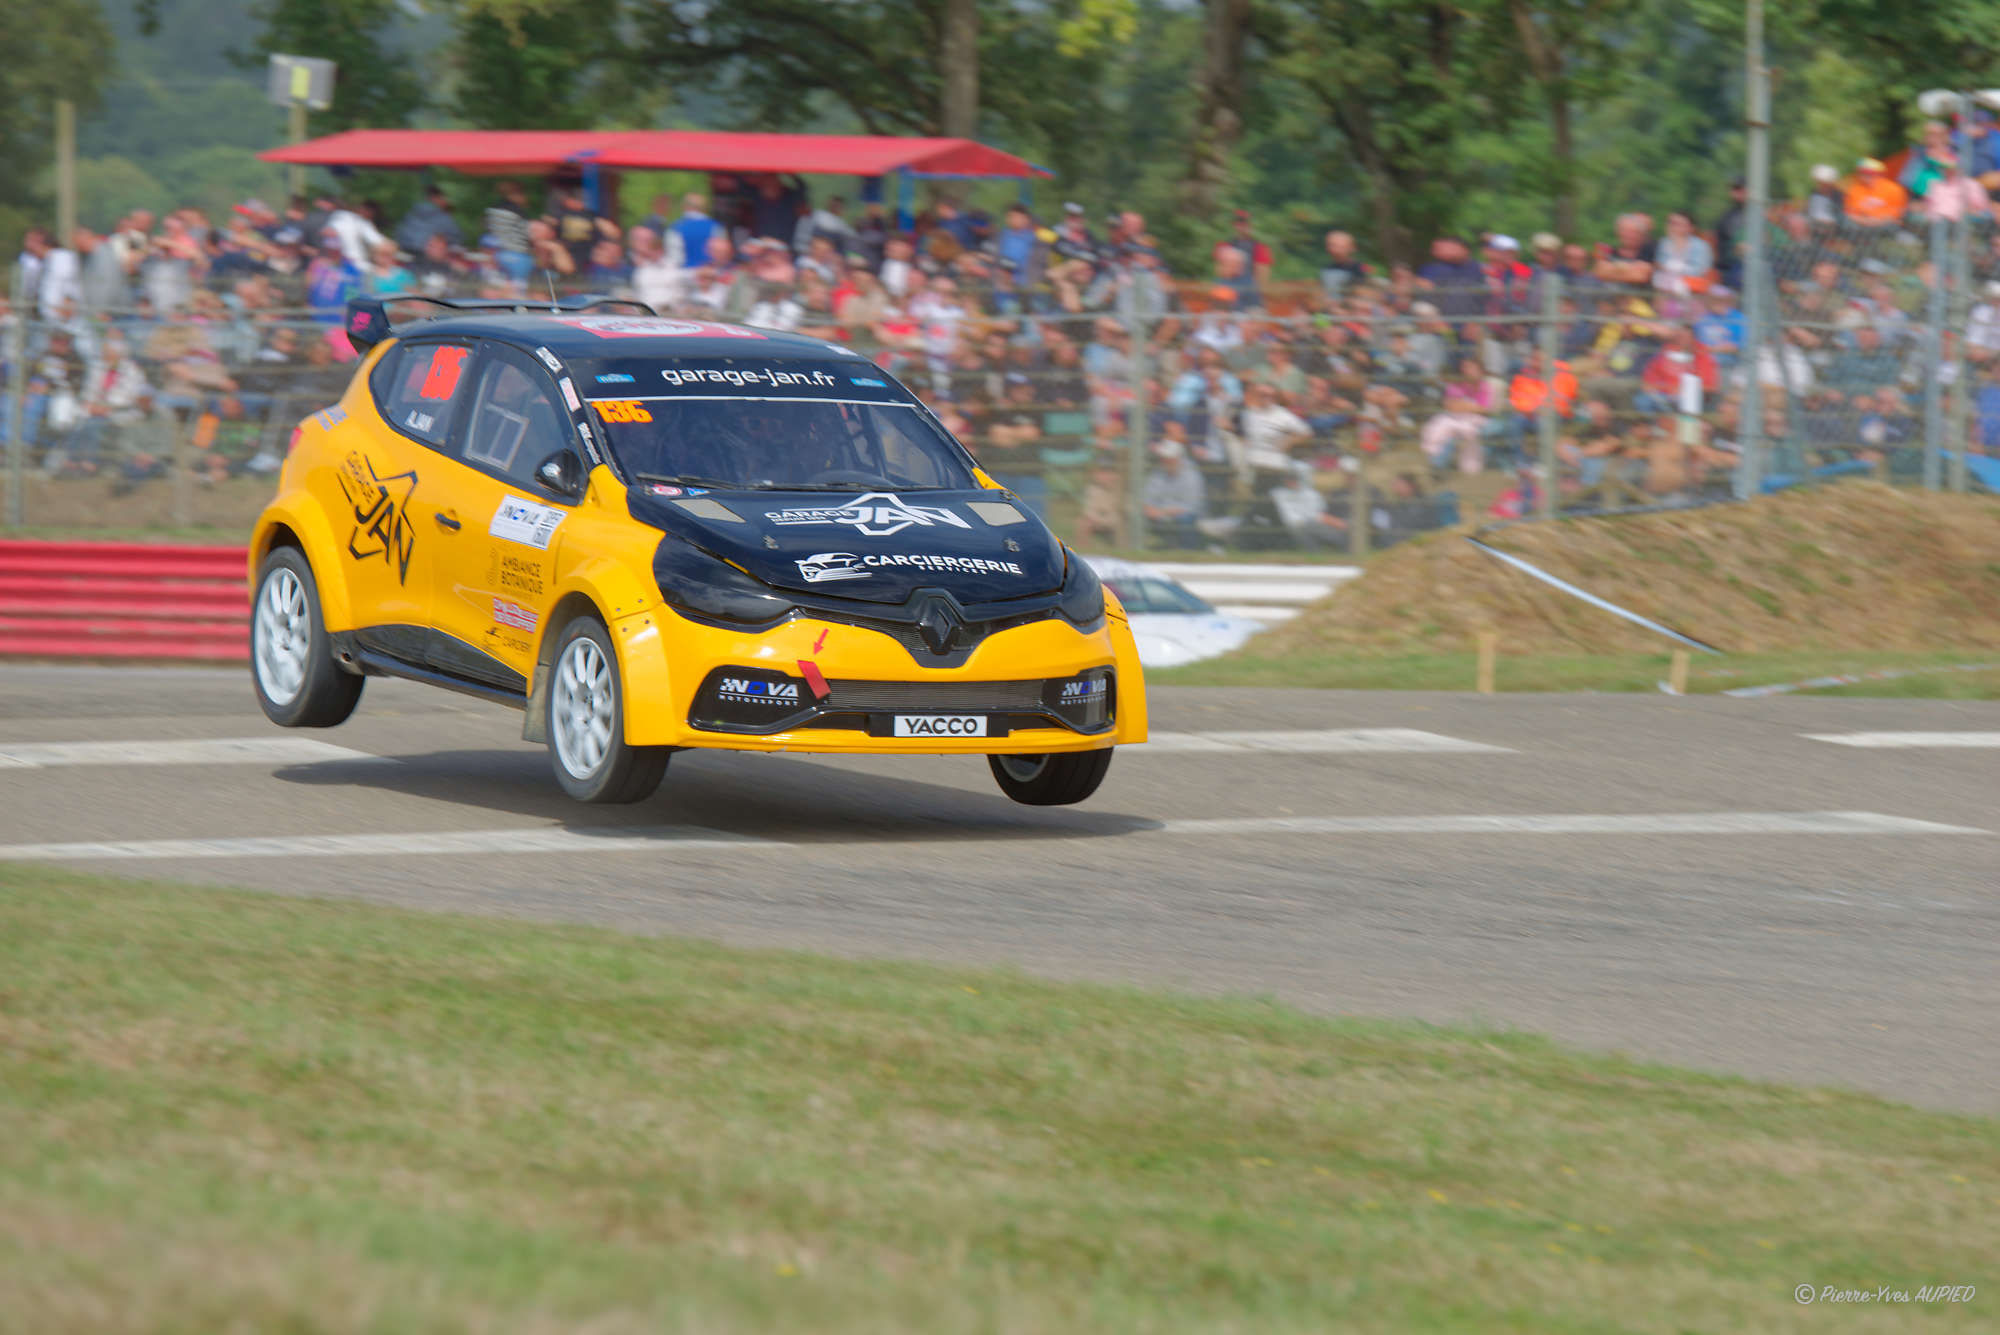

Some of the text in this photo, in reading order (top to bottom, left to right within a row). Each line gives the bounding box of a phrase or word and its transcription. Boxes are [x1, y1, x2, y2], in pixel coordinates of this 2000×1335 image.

[661, 368, 835, 387] garage-jan.fr
[591, 400, 653, 423] 136
[764, 509, 852, 519] GARAGE
[834, 506, 973, 529] JAN
[863, 554, 1023, 575] CARCIERGERIE
[726, 679, 799, 697] NOVA
[718, 694, 799, 706] MOTORSPORT
[904, 718, 978, 734] YACCO
